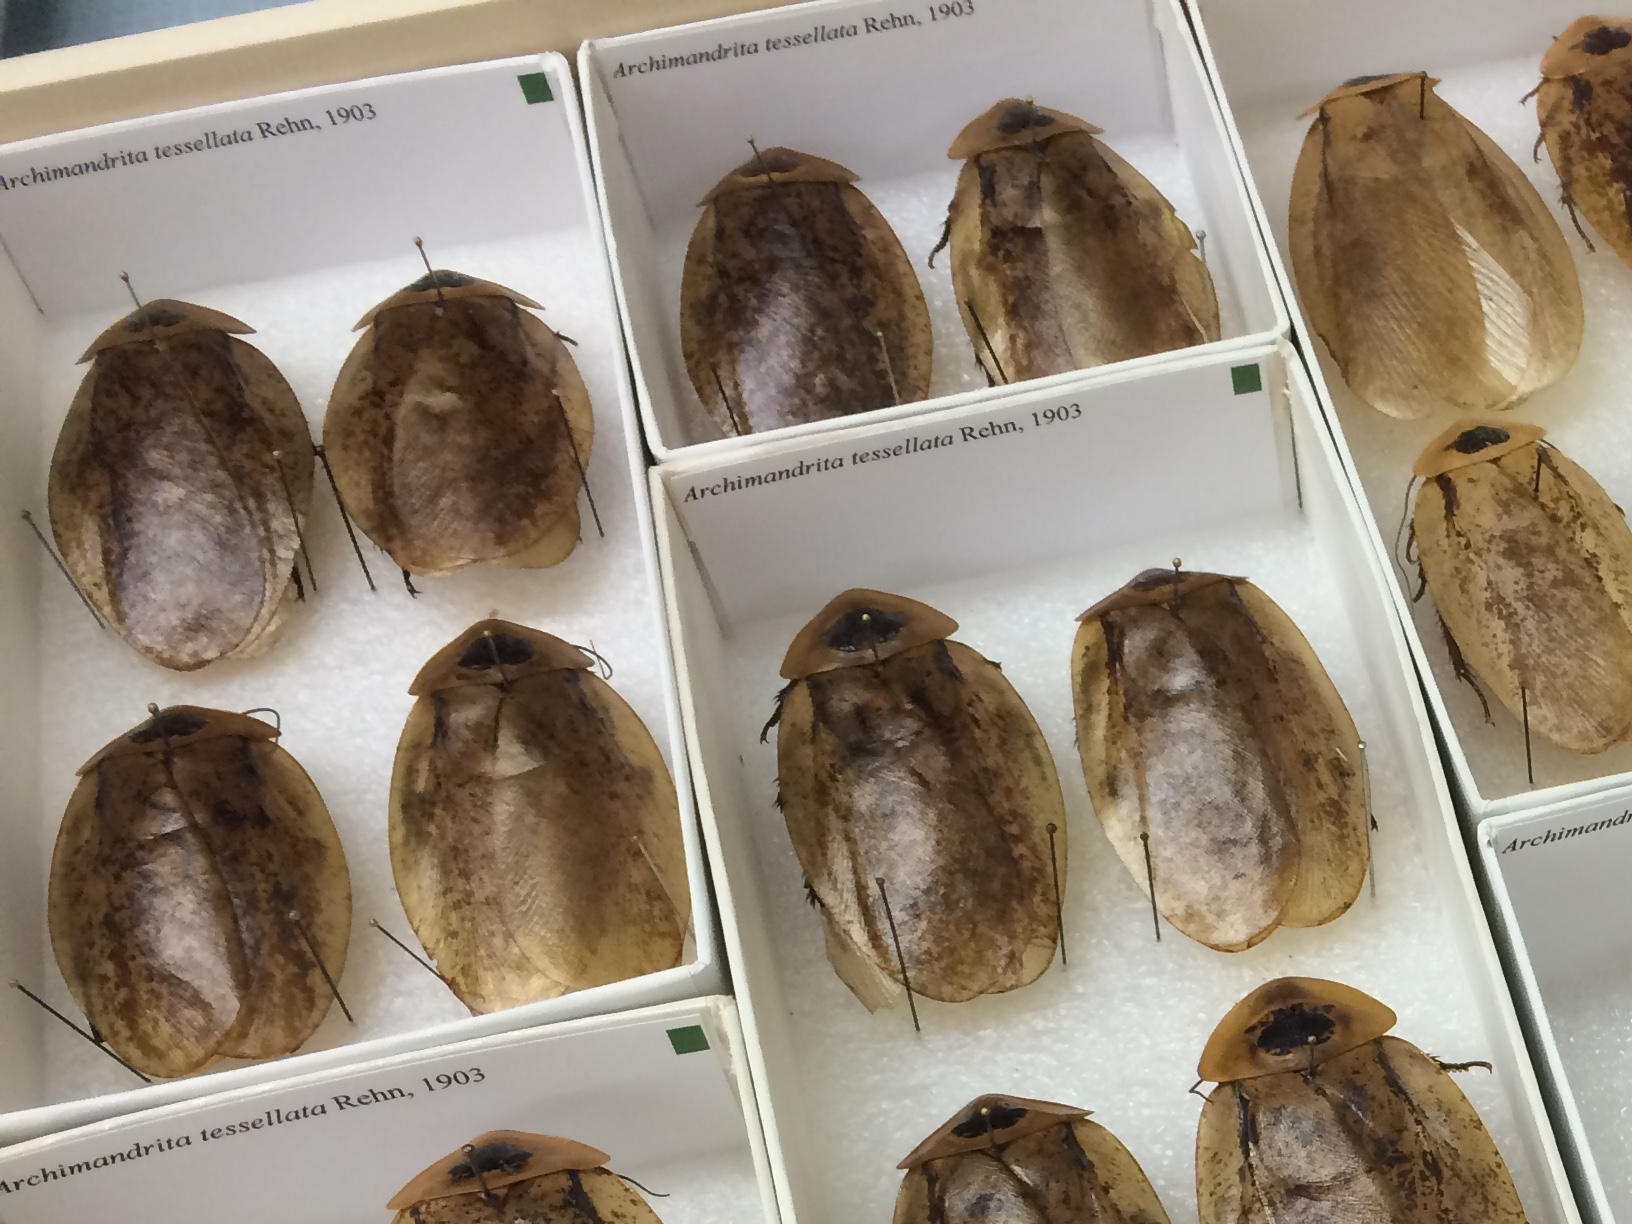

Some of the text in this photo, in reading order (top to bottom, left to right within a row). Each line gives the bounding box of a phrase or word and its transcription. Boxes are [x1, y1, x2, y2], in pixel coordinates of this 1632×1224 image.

[613, 0, 975, 79] Archimandrita tessellata Rehn, 1903
[155, 129, 254, 160] tessellata
[256, 117, 322, 140] Rehn,
[325, 103, 377, 126] 1903
[683, 403, 1082, 503] Archimandrita tessellata Rehn, 1903
[200, 1102, 328, 1142] tessellata
[331, 1087, 414, 1111] Rehn,
[421, 1067, 486, 1092] 1903
